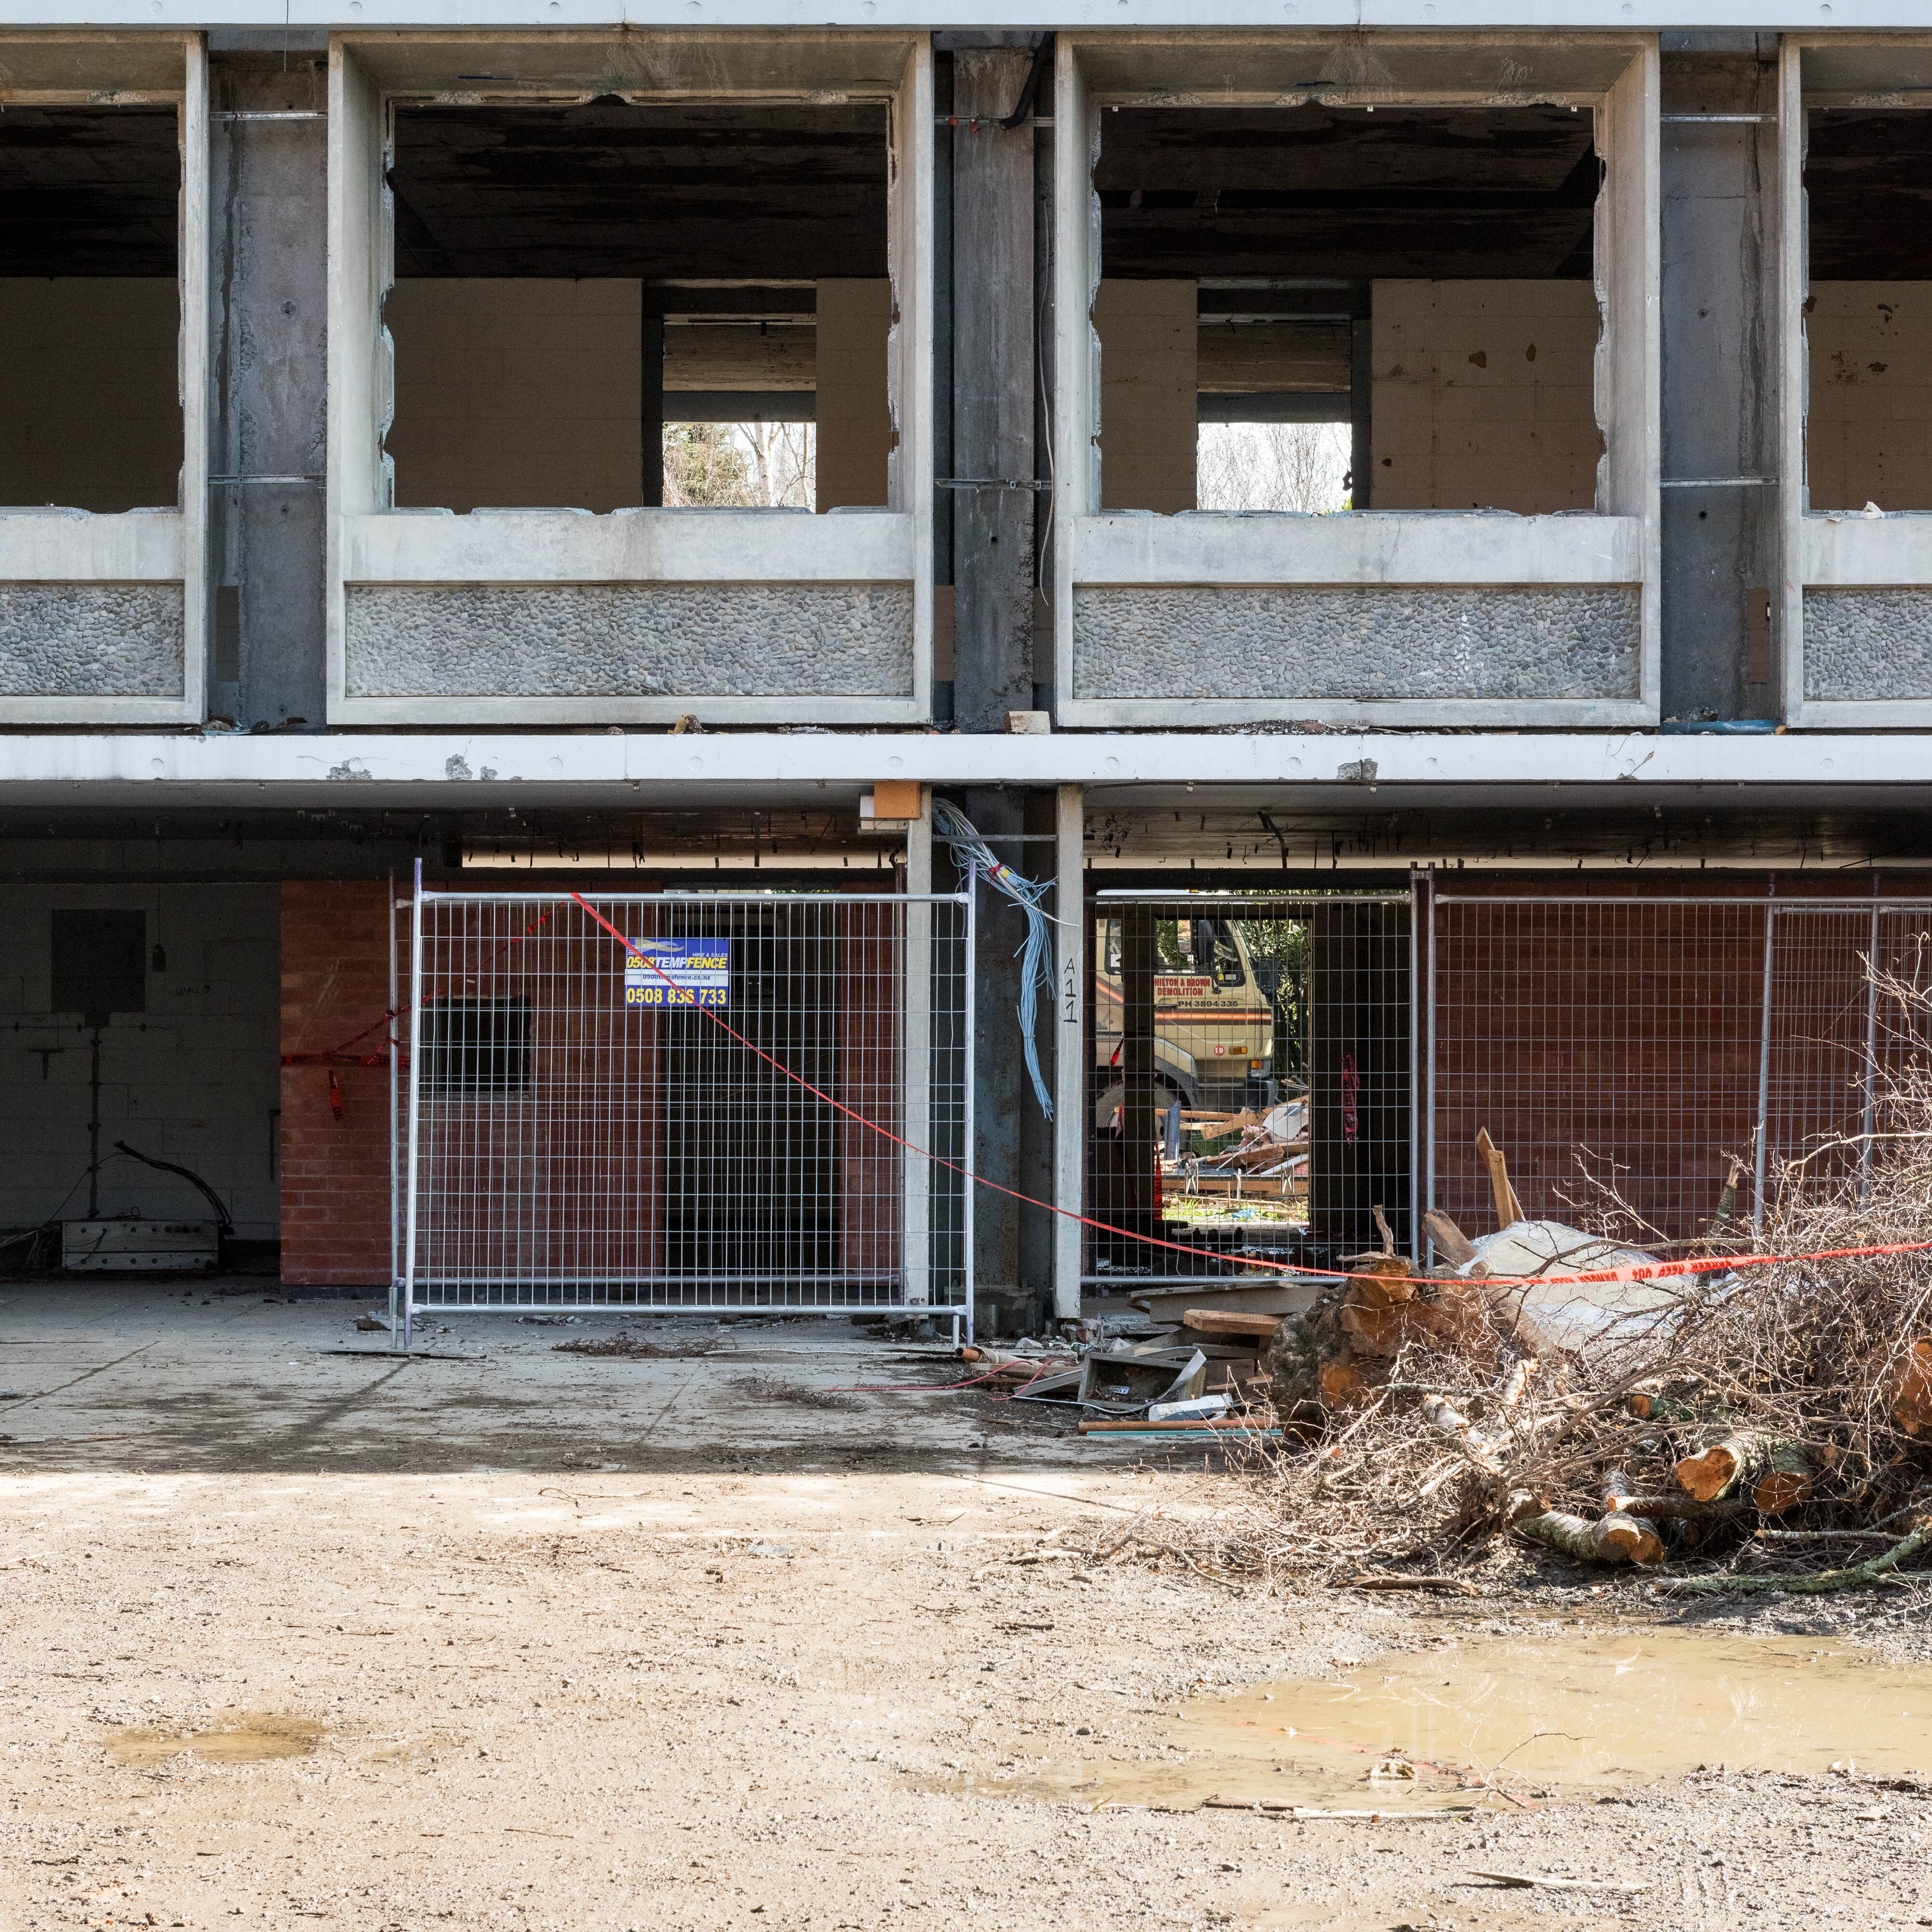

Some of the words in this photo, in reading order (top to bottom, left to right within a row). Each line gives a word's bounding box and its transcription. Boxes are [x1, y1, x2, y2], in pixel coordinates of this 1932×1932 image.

[1180, 979, 1185, 987] &
[1187, 979, 1210, 987] BROWN
[1157, 988, 1203, 996] DEMOLITION
[627, 988, 662, 1004] 0508
[668, 989, 695, 1004] 836
[700, 989, 726, 1005] 733
